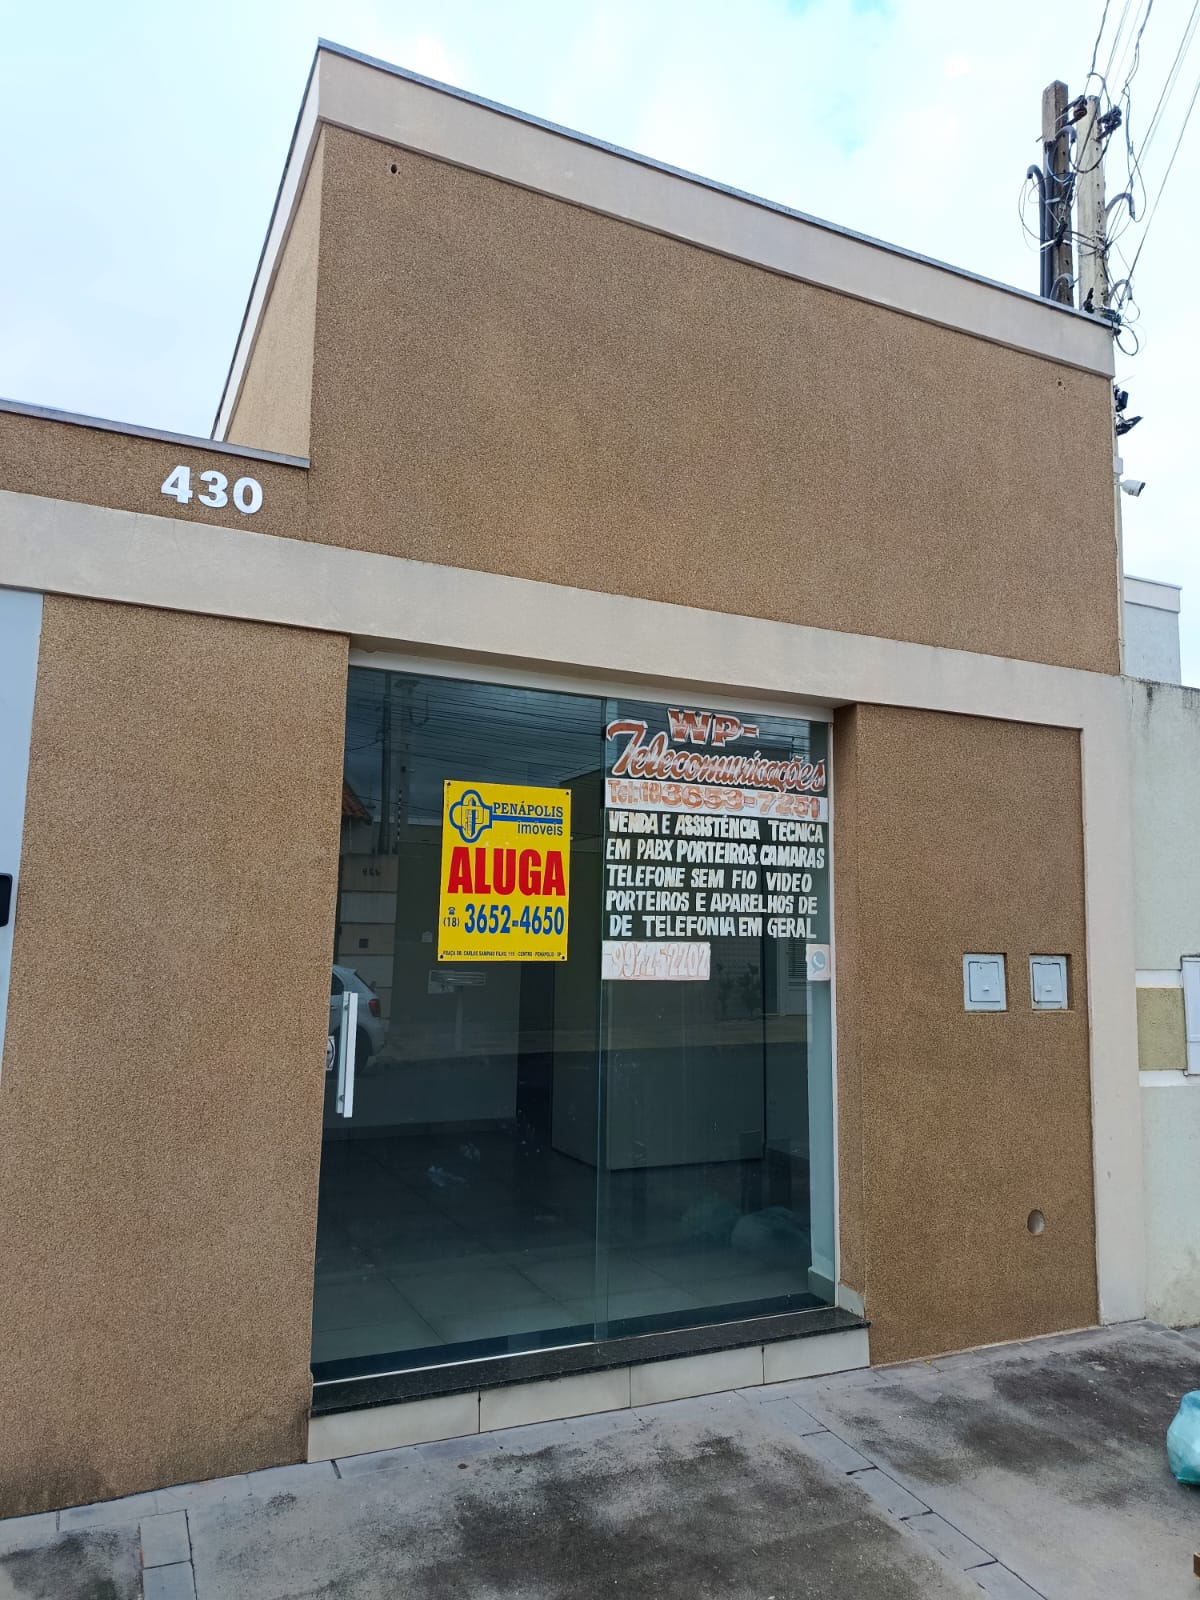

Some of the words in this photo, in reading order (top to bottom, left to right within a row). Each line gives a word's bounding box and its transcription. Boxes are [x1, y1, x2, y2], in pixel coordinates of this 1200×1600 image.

[160, 465, 263, 515] 430
[606, 719, 825, 793] Telecomunicações
[492, 800, 563, 819] PENÁPOLIS
[662, 783, 820, 820] 3653-7251
[517, 820, 563, 836] imóveis
[608, 811, 658, 835] VENDA
[662, 814, 671, 834] E
[768, 819, 824, 844] TECNICA
[606, 838, 631, 861] EM
[637, 839, 673, 862] PABX
[760, 847, 825, 869] CAMARAS
[447, 846, 566, 896] ALUGA
[606, 864, 686, 888] TELEFONE
[691, 867, 725, 889] SEM
[732, 870, 757, 890] FIO
[766, 871, 813, 893] VIDEO
[606, 890, 690, 912] PORTEIROS
[696, 892, 706, 912] E
[710, 892, 794, 914] APARELHOS
[798, 896, 818, 914] DE
[443, 916, 460, 928] (18)
[464, 903, 565, 936] 3652-4650
[609, 914, 633, 937] DE
[642, 915, 736, 938] TELEFONIA
[738, 916, 763, 938] EM
[767, 917, 817, 939] GERAL
